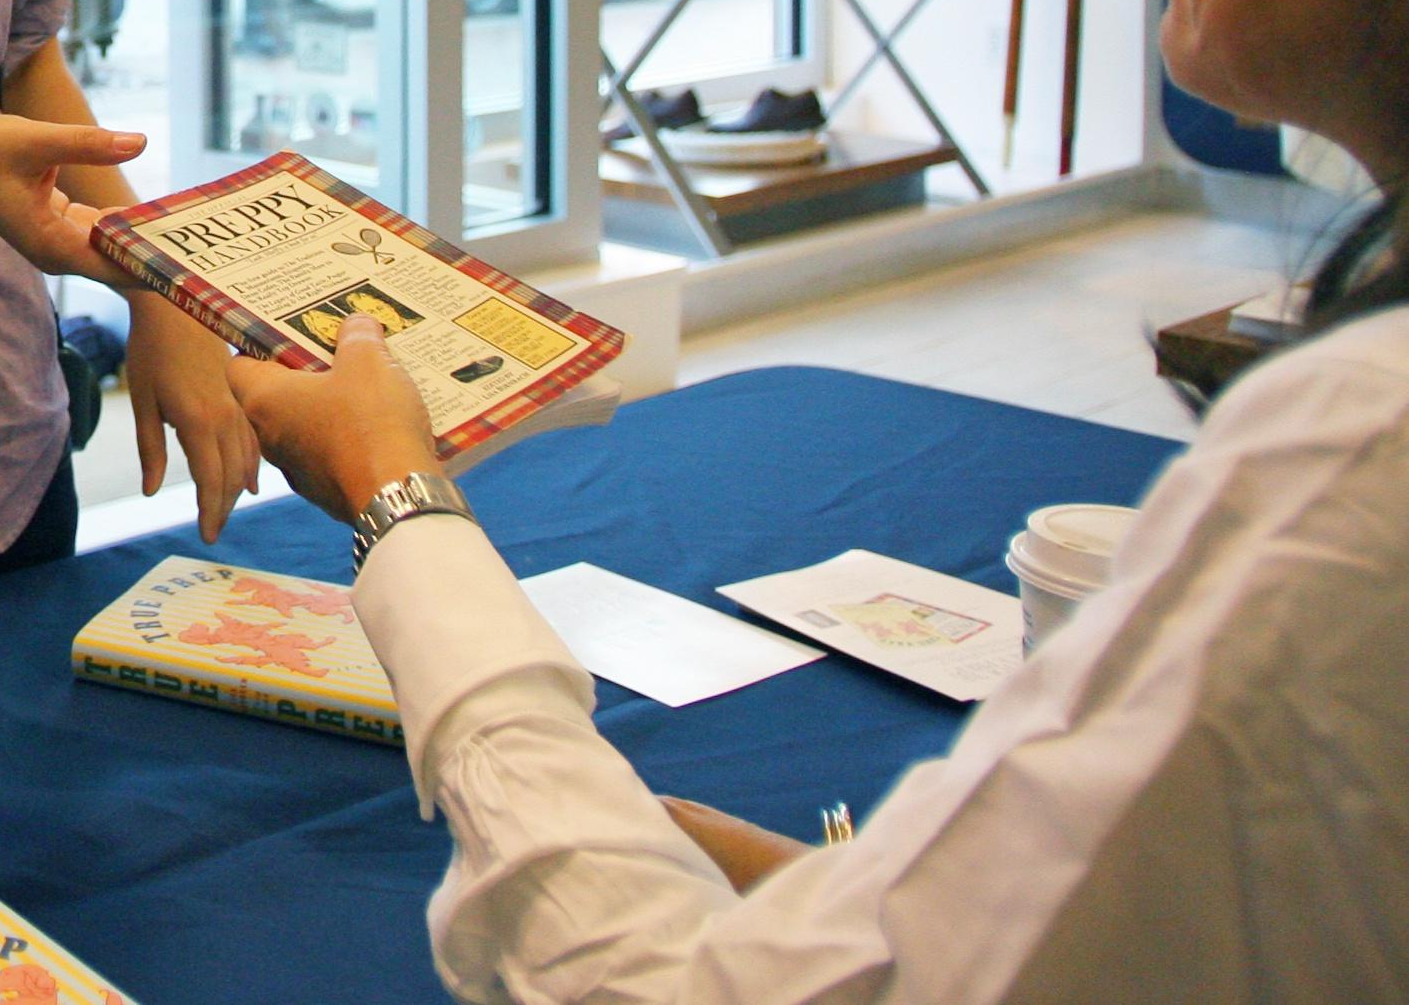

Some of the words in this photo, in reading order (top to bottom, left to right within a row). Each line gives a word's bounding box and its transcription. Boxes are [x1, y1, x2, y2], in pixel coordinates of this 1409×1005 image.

[161, 184, 314, 255] PREPPY
[189, 204, 345, 271] HANDBOOK
[150, 568, 234, 596] PREP
[130, 599, 171, 644] TRUE
[84, 655, 218, 699] TRUE
